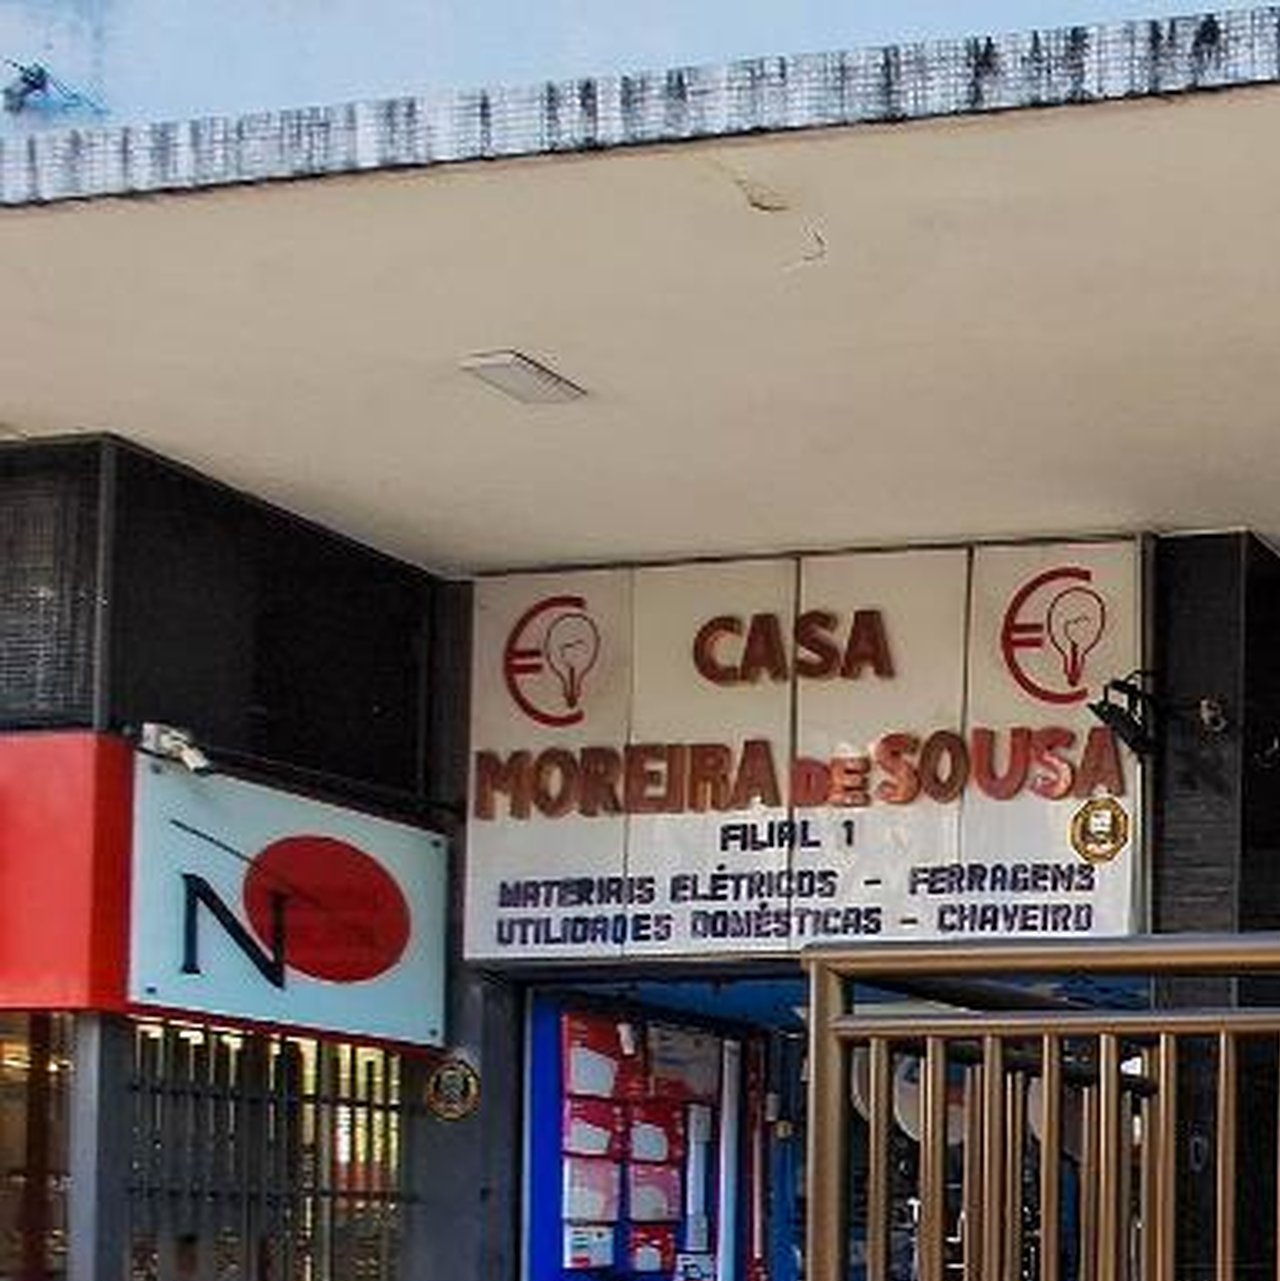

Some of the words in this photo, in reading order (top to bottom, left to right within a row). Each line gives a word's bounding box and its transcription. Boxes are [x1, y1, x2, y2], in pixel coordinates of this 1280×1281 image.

[694, 611, 895, 684] CASA
[474, 739, 783, 818] MOREIRA
[790, 755, 872, 807] DE
[873, 726, 1125, 804] SOUSA
[720, 819, 822, 851] FILIAL
[841, 819, 856, 847] 1
[499, 876, 655, 908] MATERIAIS
[669, 863, 838, 902] ELÉTRICOS
[908, 863, 1096, 896] FERRAGENS
[690, 901, 883, 938] DOMÉSTICAS
[936, 903, 1093, 933] CHAVEIRO
